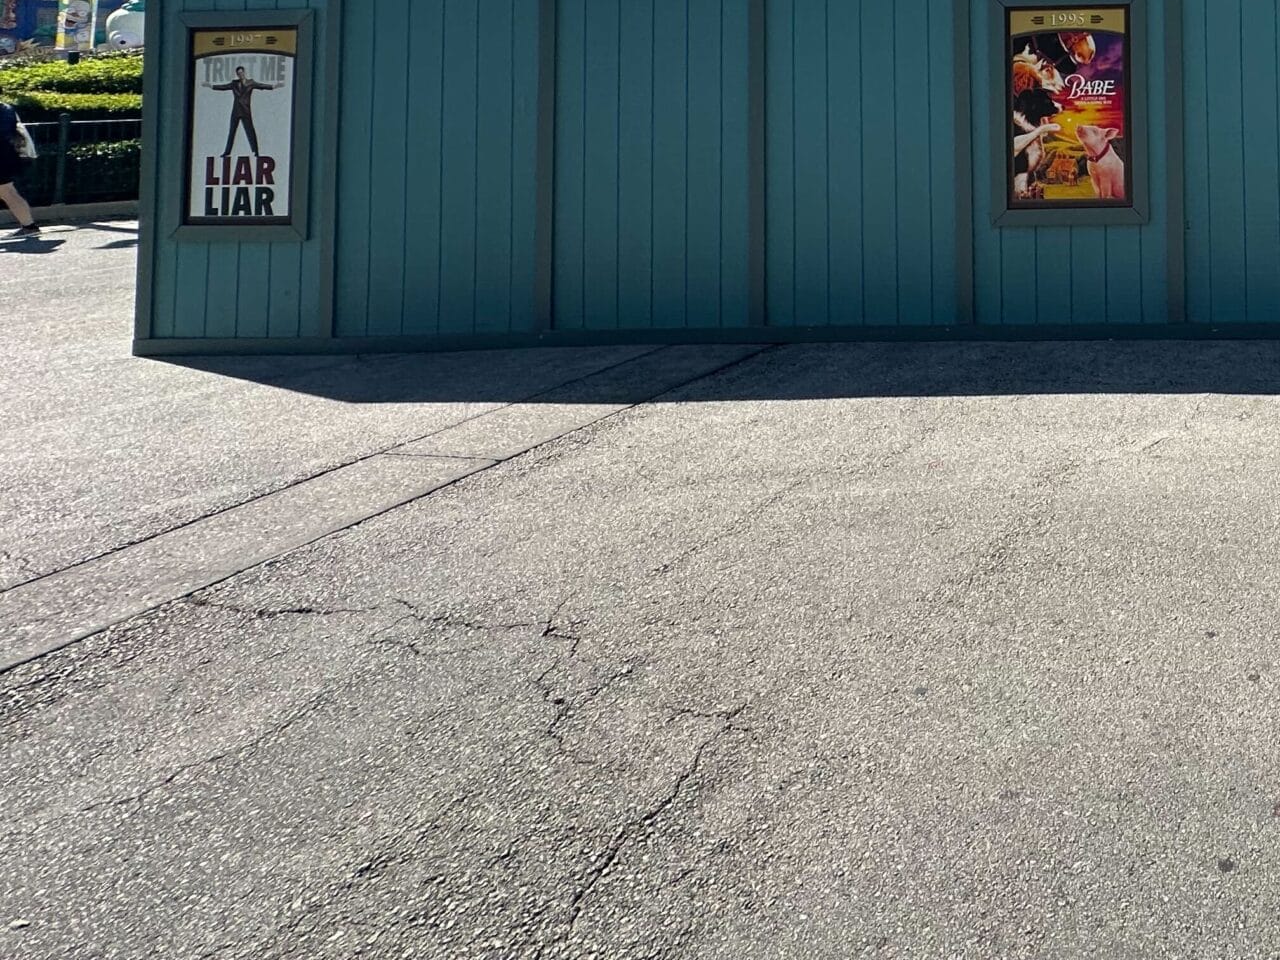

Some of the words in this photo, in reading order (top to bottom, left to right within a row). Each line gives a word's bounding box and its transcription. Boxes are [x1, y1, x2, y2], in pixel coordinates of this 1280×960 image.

[1051, 13, 1086, 26] 1995
[260, 55, 287, 81] ME
[1064, 73, 1116, 99] BABE
[205, 156, 275, 186] LIAR
[204, 186, 274, 216] LIAR
